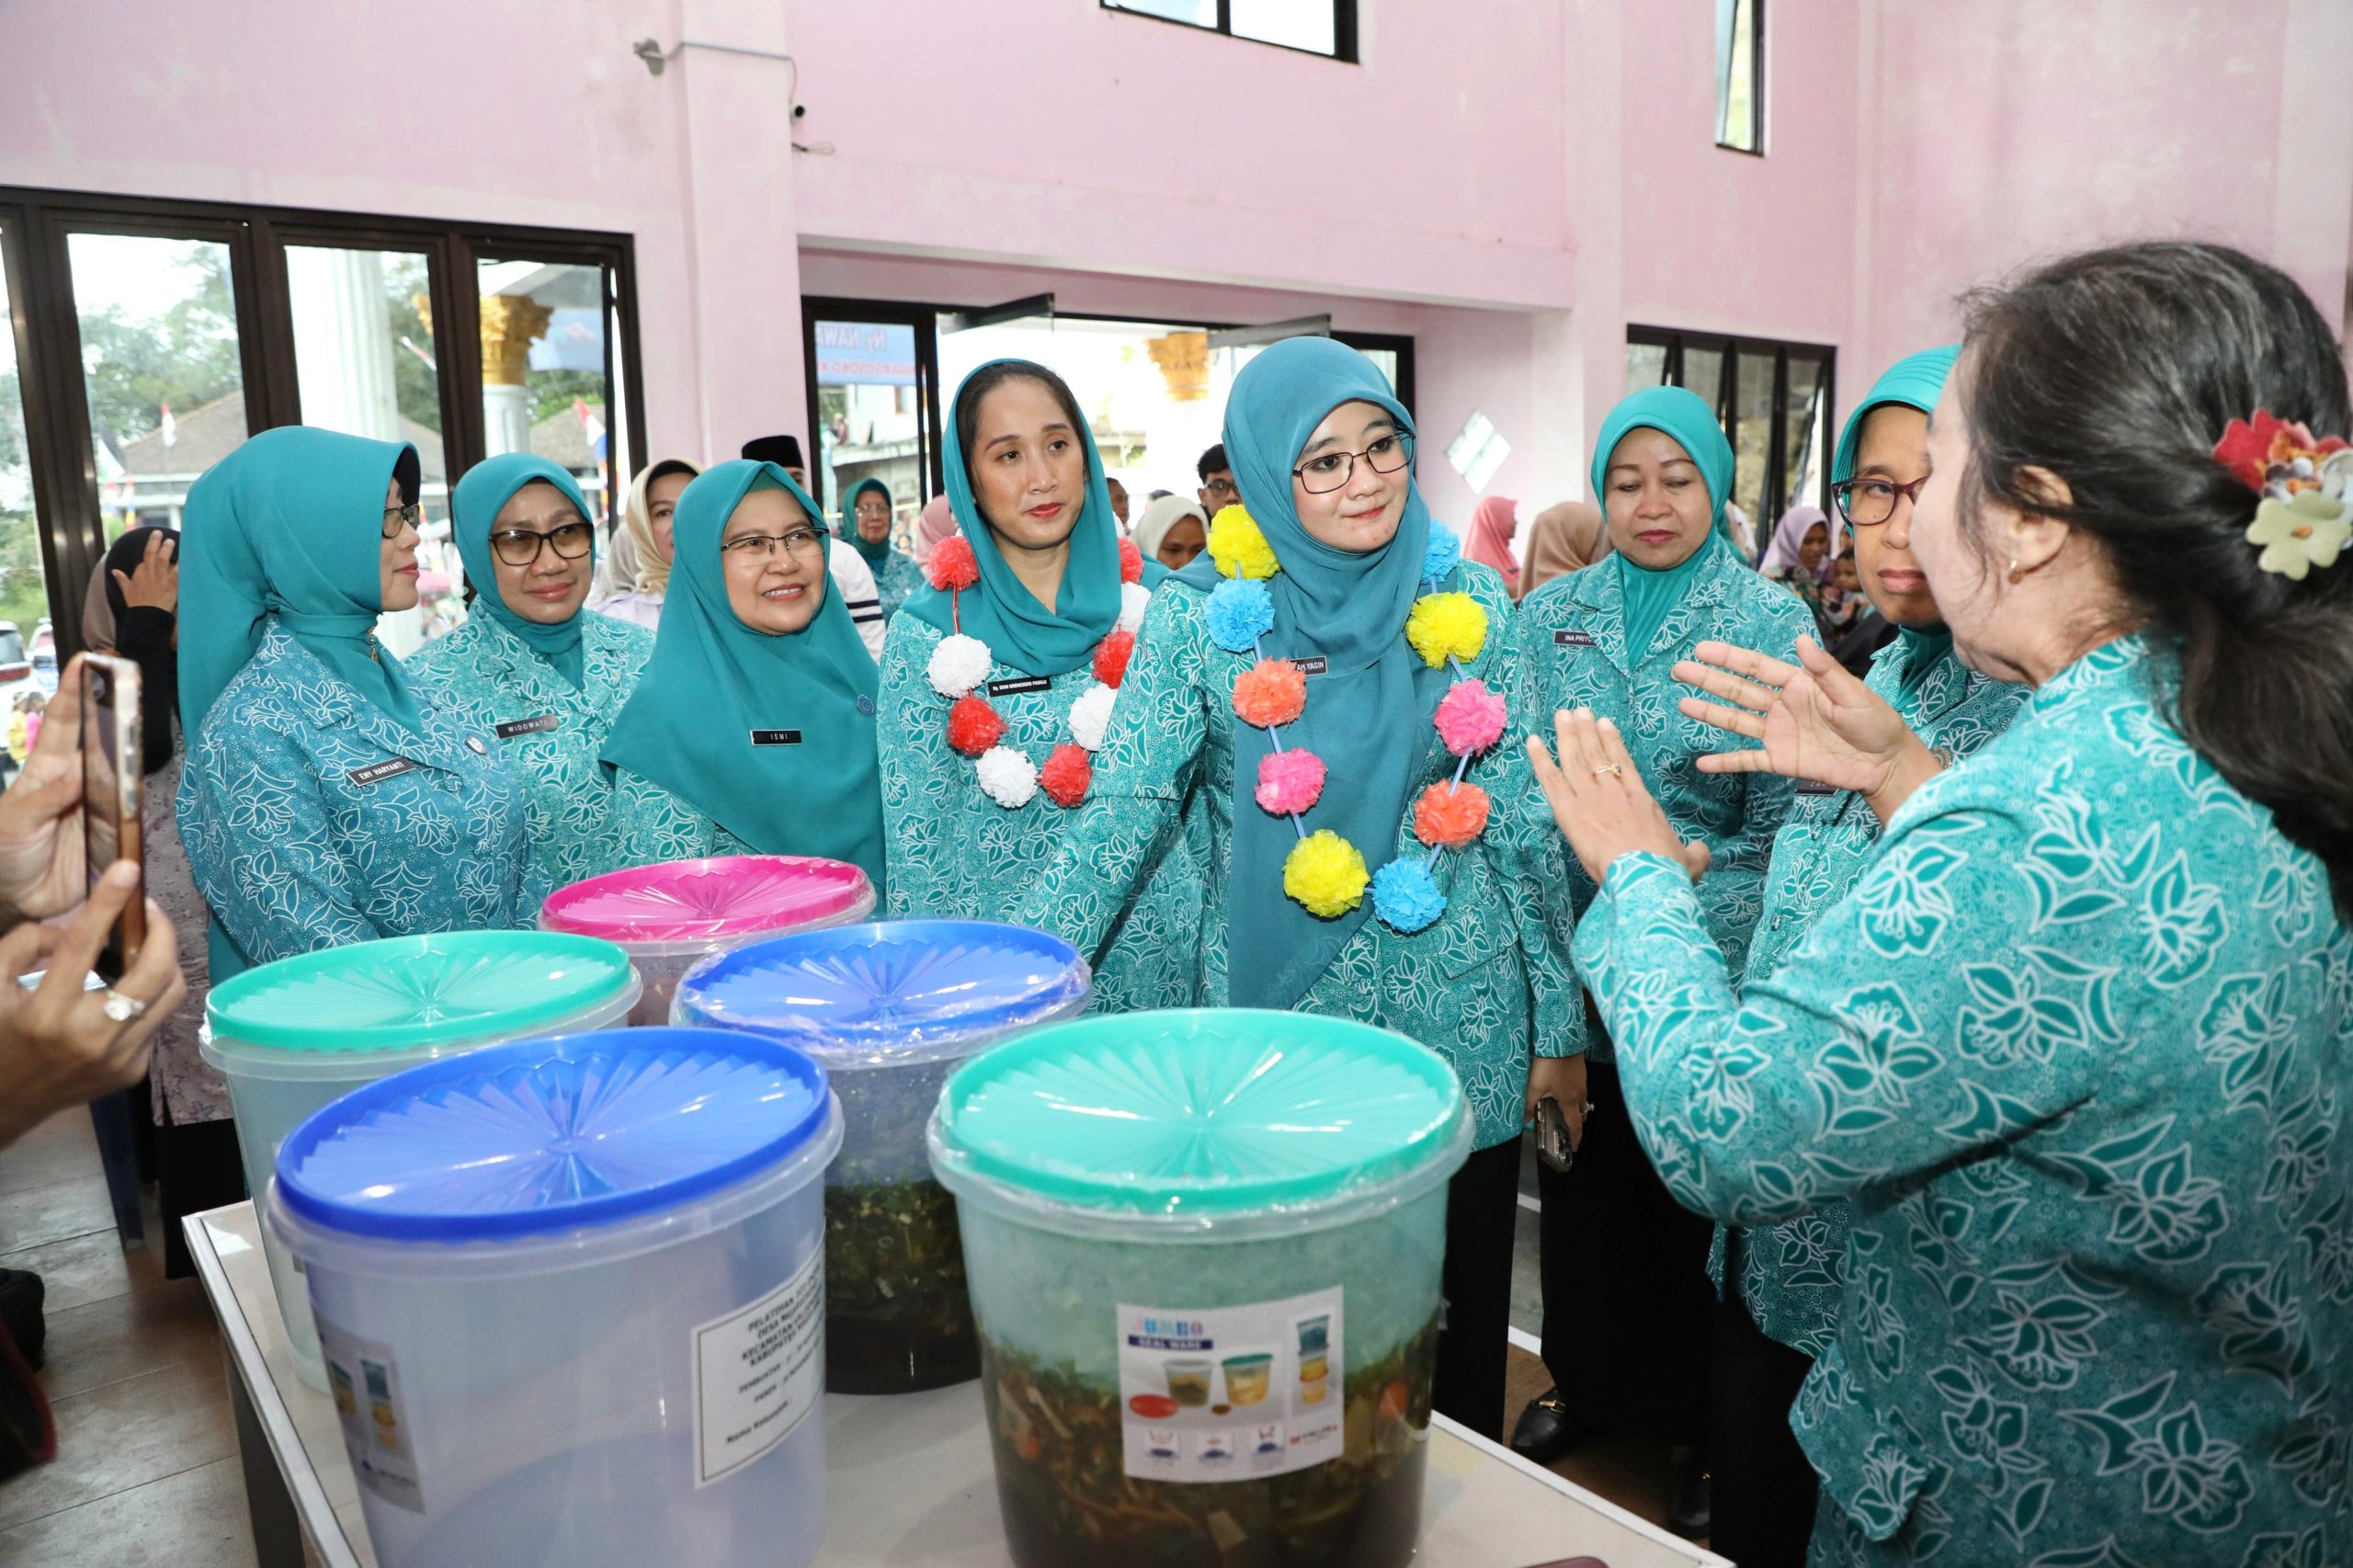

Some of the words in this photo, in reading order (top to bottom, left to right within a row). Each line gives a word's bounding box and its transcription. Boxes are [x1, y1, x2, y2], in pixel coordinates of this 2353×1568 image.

[1306, 662, 1324, 670] YASIN
[507, 720, 548, 733] WIDOWATI
[770, 733, 788, 741] ISMI
[358, 770, 374, 780] ENY
[372, 761, 405, 776] HARYANTI
[748, 1296, 795, 1333] PELATIHAN
[758, 1320, 779, 1339] DESA
[743, 1324, 794, 1360] KECAMATAN
